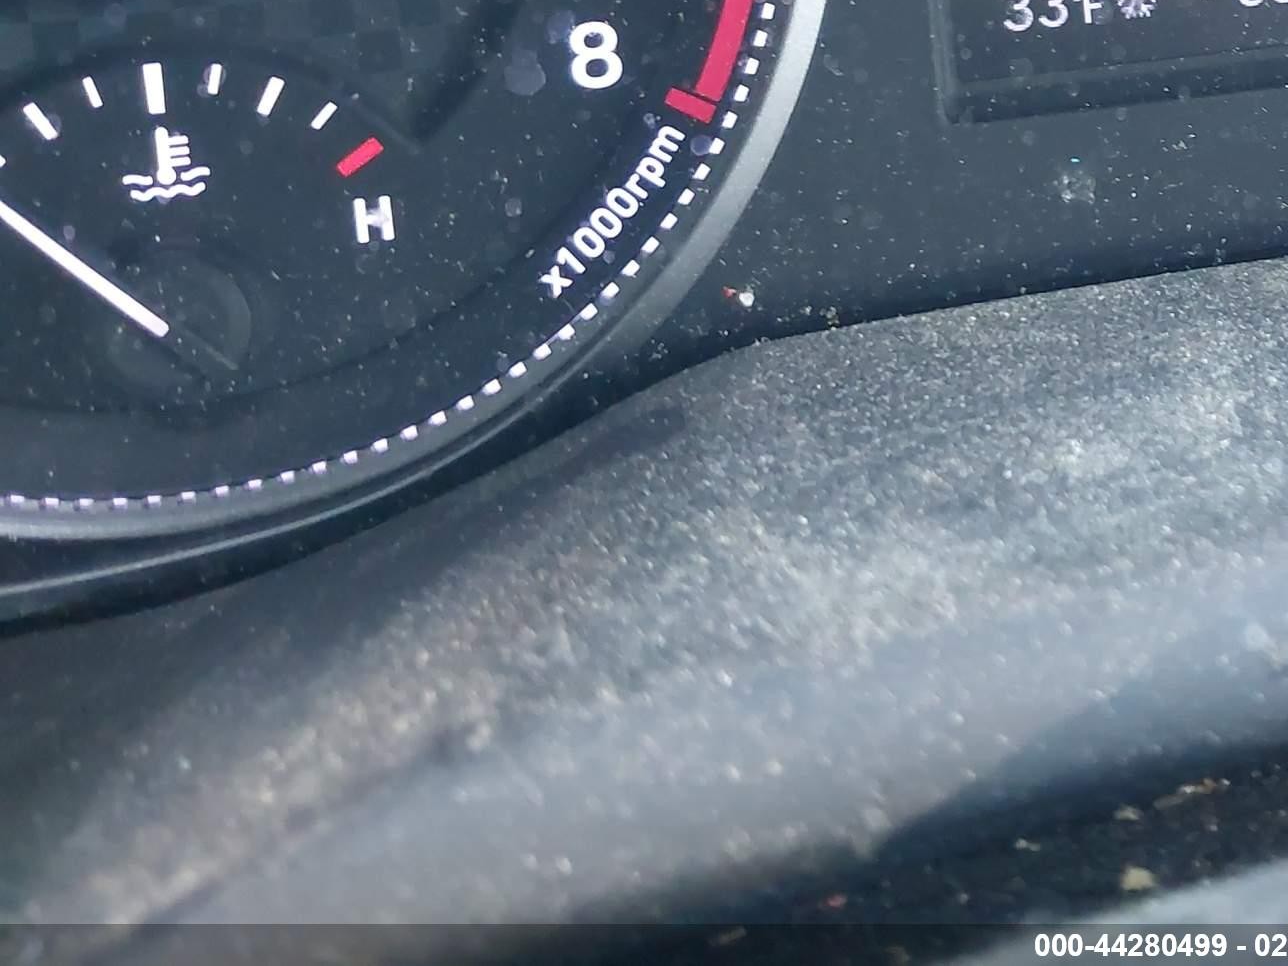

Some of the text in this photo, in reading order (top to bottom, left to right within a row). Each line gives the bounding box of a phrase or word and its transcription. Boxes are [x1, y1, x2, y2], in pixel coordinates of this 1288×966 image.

[567, 22, 624, 90] 8
[352, 195, 396, 245] H
[540, 124, 686, 299] x1000rpm
